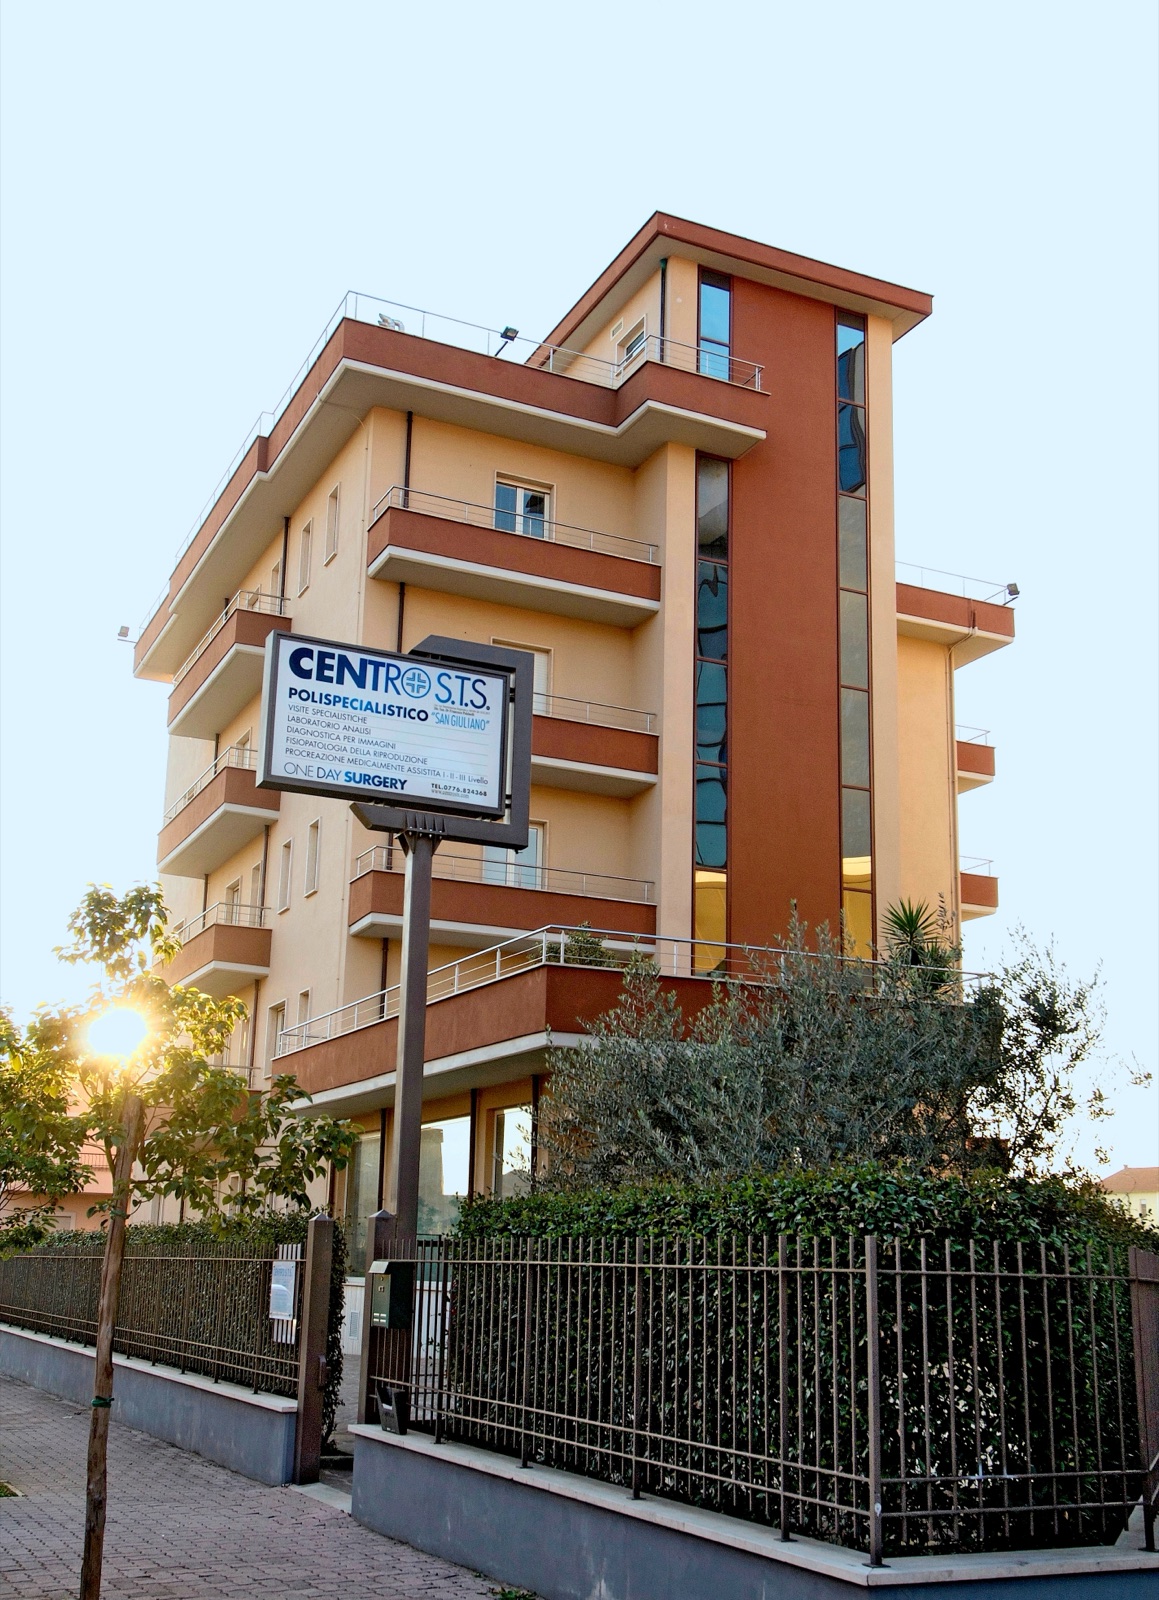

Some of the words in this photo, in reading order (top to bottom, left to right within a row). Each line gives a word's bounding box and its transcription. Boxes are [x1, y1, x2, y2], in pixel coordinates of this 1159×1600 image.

[289, 647, 431, 699] CENTRO
[434, 672, 491, 711] S.T.S.
[288, 687, 429, 722] POLISPECIALISTICO
[288, 704, 309, 714] VISITE
[311, 708, 368, 724] SPECIALISTICHE
[286, 725, 341, 741] DIAGNOSTICA
[343, 735, 356, 744] PER
[357, 737, 397, 750] IMMAGINI
[287, 714, 341, 730] LABORATORIO
[342, 725, 372, 735] ANALISI
[285, 736, 348, 753] FISIOPATOLOGIA
[350, 747, 371, 757] DELLA
[373, 750, 428, 765] RIPRODUZIONE
[283, 761, 314, 778] ONE
[316, 766, 342, 781] DAY
[344, 771, 408, 790] SURGERY
[285, 747, 345, 764] PROCREAZIONE
[346, 758, 404, 773] MEDICALMENTE
[406, 766, 441, 778] ASSISTITA
[468, 775, 489, 785] Livello
